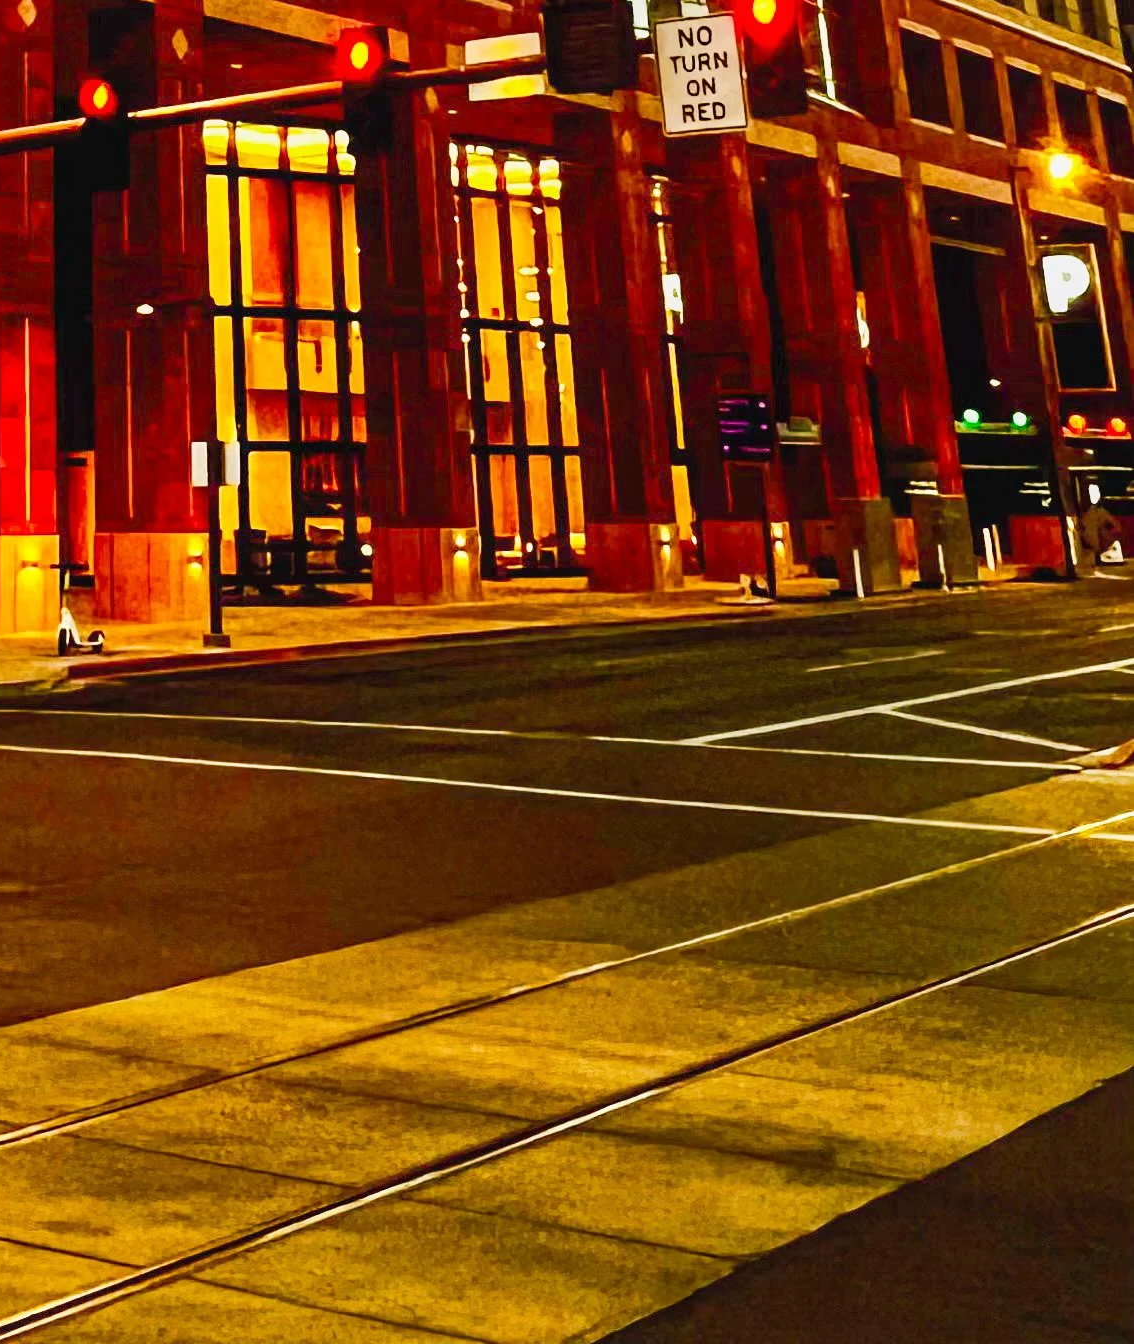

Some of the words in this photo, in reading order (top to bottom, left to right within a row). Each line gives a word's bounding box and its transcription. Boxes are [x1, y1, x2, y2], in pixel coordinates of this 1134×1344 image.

[677, 25, 713, 49] NO
[669, 51, 729, 75] TURN
[686, 77, 717, 97] ON
[681, 101, 726, 124] RED
[1042, 254, 1091, 313] P
